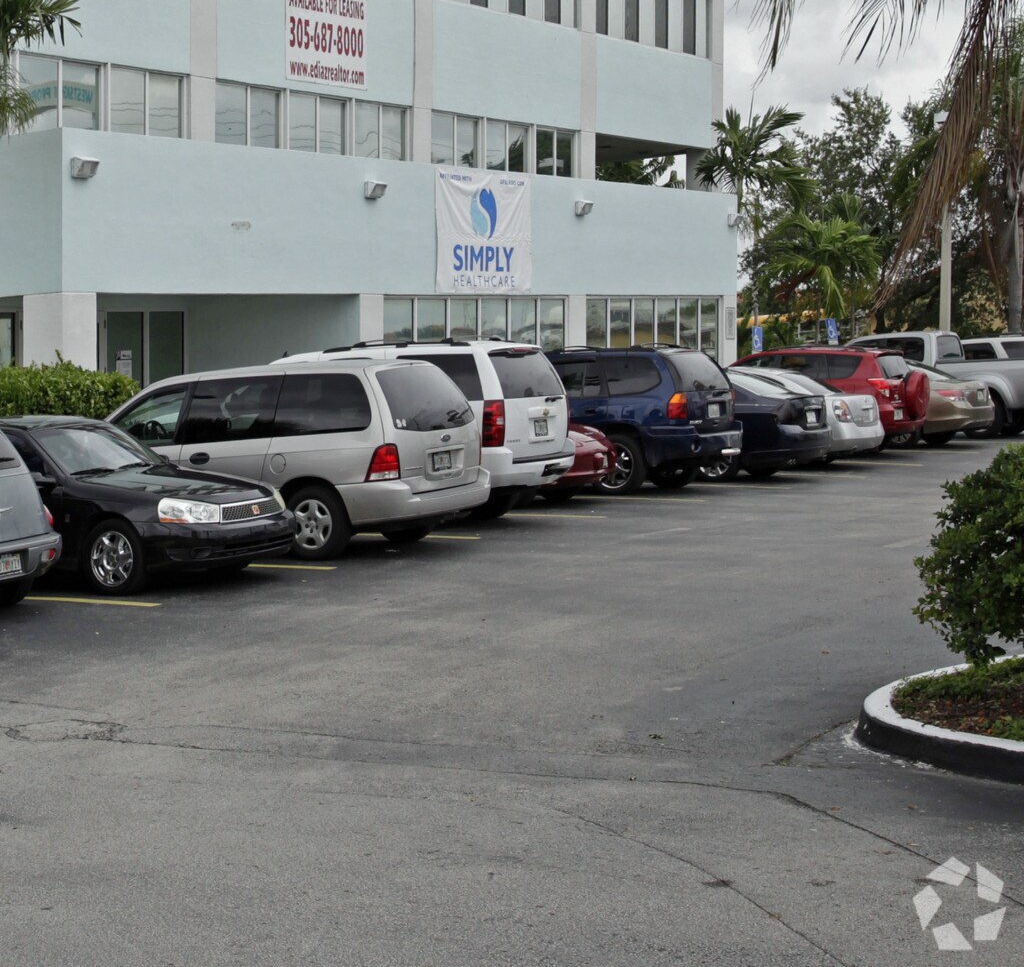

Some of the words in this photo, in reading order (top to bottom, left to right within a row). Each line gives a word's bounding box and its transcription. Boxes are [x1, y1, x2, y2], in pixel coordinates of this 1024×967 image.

[289, 16, 364, 59] 305-687-8000
[289, 60, 365, 86] www.ediazrealtor.com
[453, 244, 514, 272] SIMPLY
[453, 274, 516, 287] HEALTHCARE
